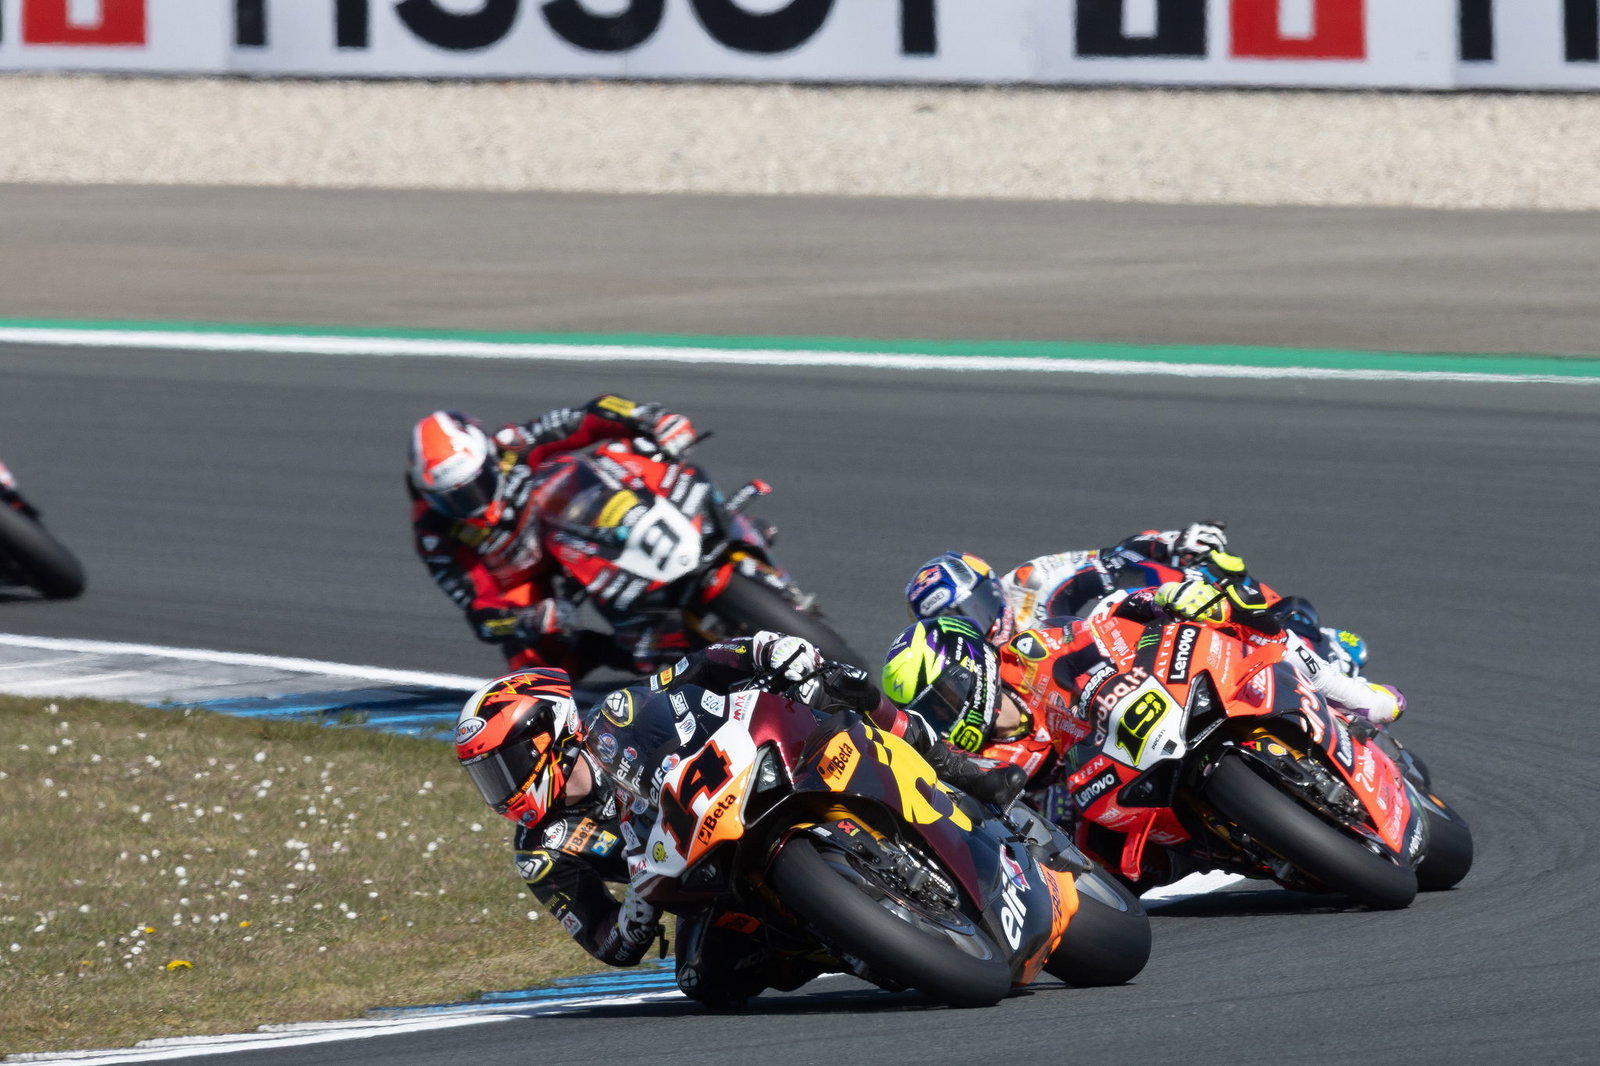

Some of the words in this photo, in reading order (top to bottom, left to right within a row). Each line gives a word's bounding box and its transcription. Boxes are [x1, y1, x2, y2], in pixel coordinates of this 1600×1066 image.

[639, 517, 681, 572] 9
[1156, 624, 1175, 678] ALTEN
[1170, 627, 1197, 680] Lenovo
[1078, 665, 1118, 718] CARRERA
[1093, 665, 1149, 746] aruba.it
[1115, 687, 1172, 767] 19
[616, 760, 632, 781] elf
[649, 767, 665, 801] elf
[833, 743, 854, 775] Beta
[661, 739, 734, 860] 14
[706, 793, 737, 831] Beta
[1075, 773, 1115, 808] Lenovo
[576, 821, 597, 846] Beta
[1001, 871, 1027, 951] elf
